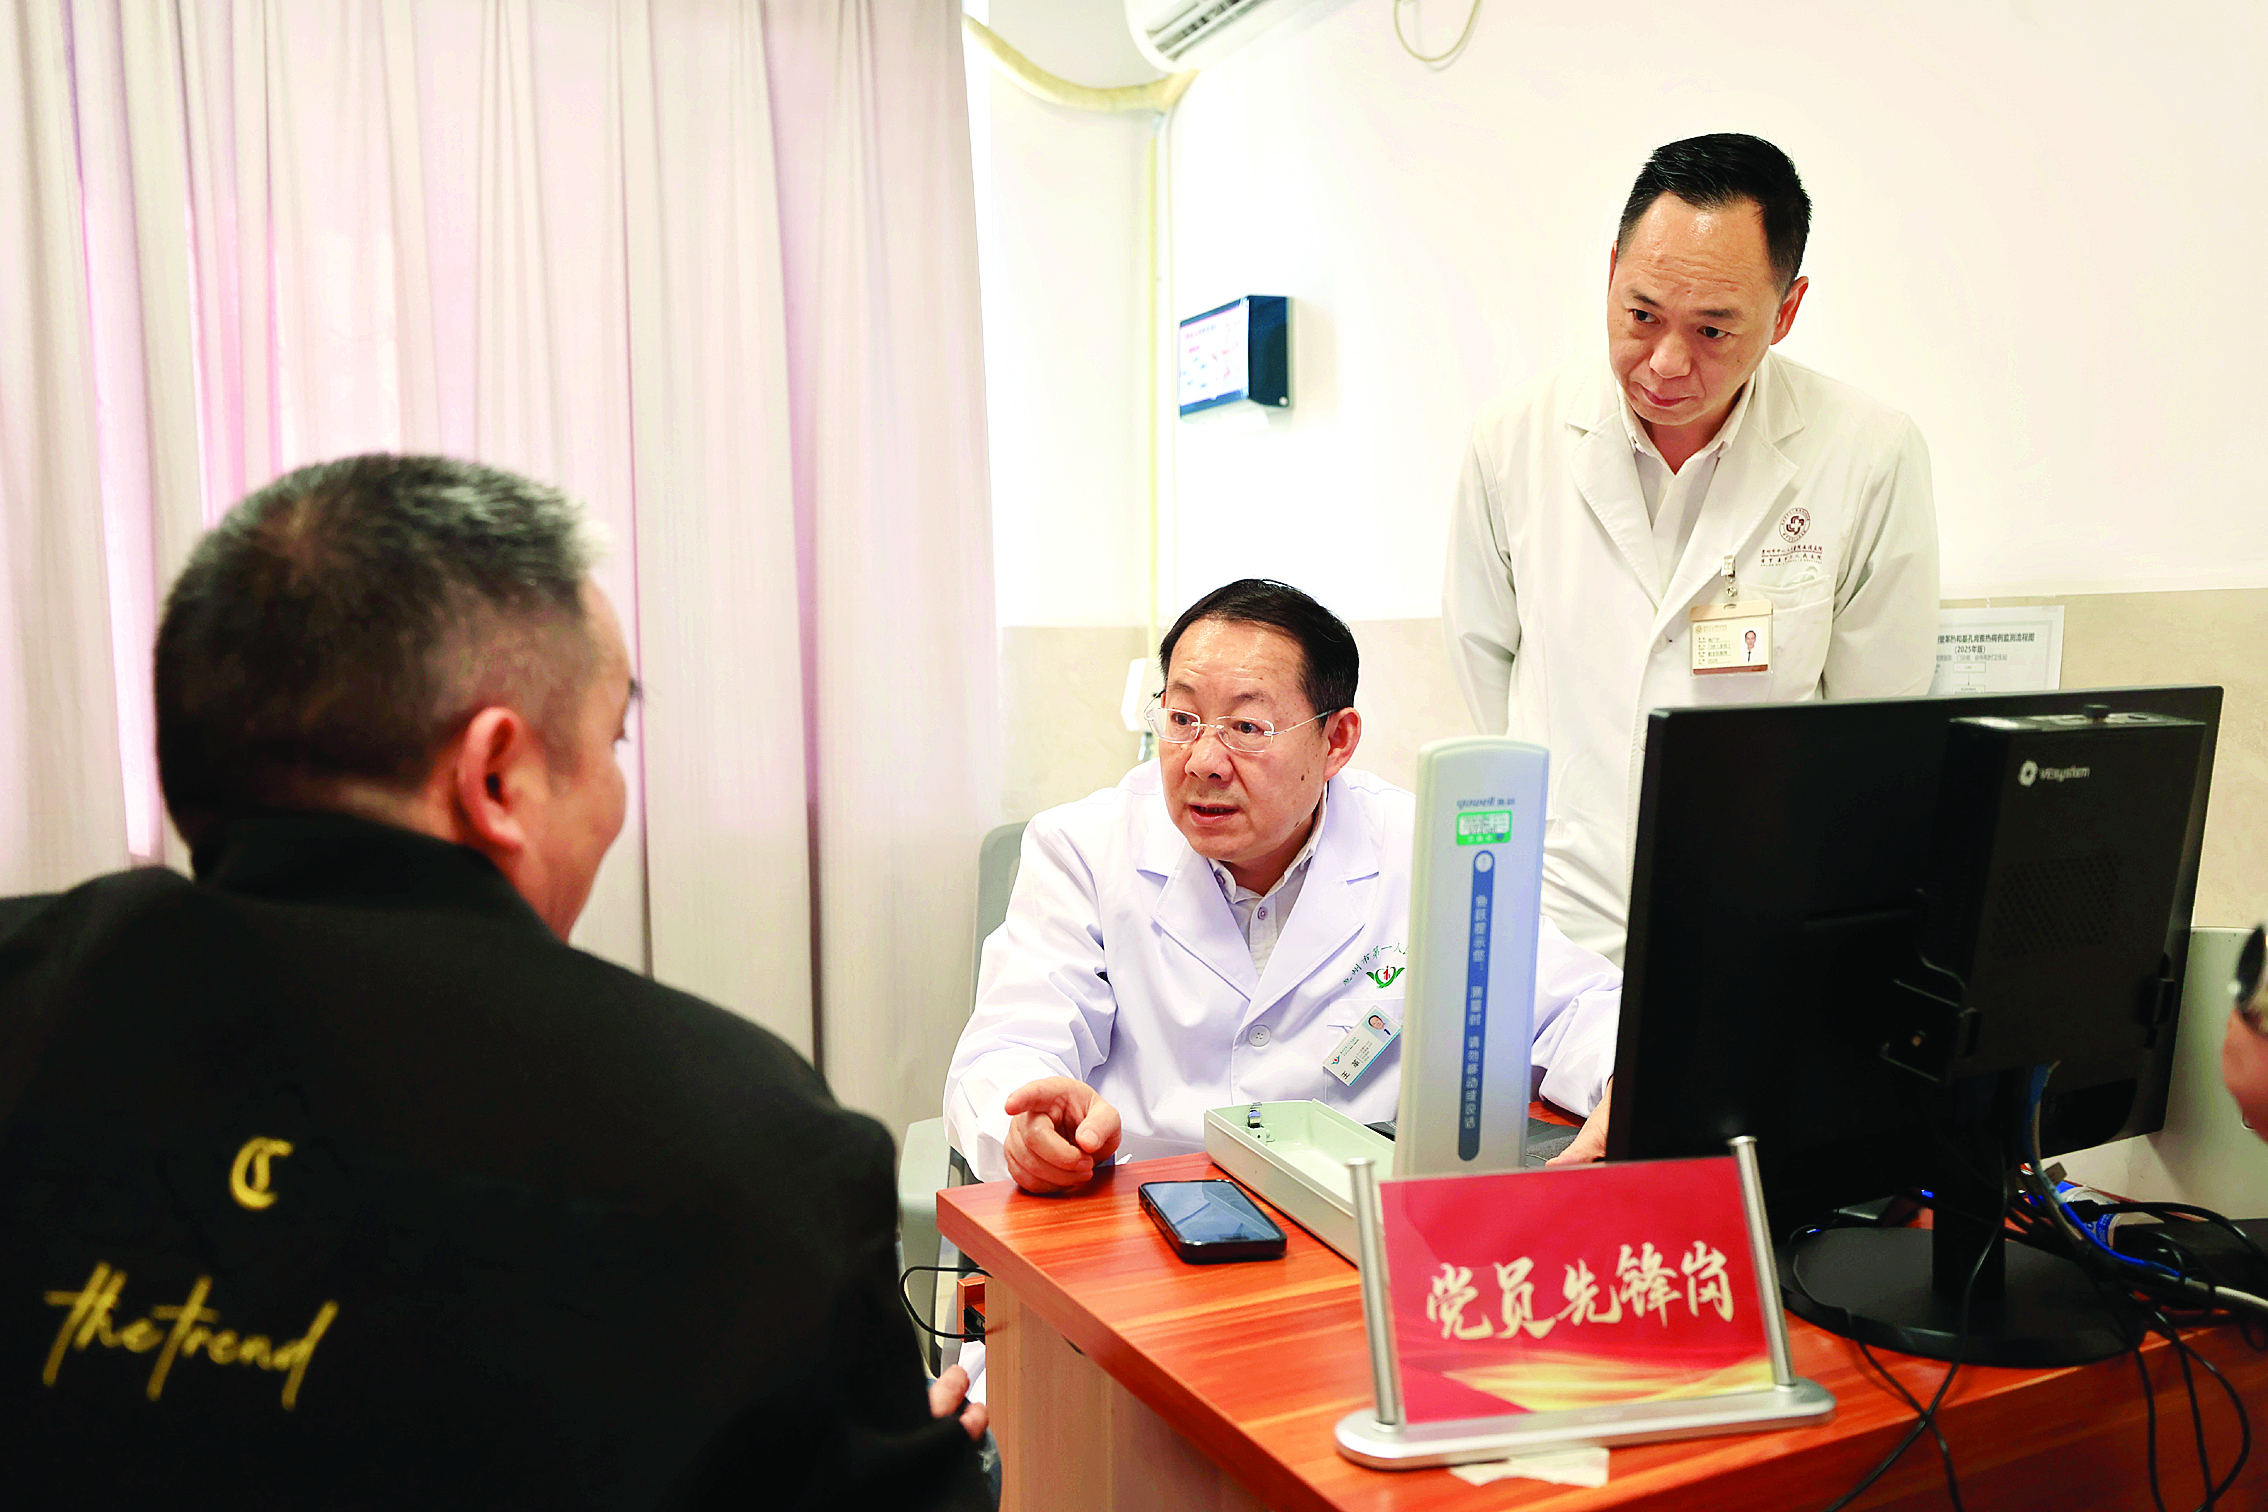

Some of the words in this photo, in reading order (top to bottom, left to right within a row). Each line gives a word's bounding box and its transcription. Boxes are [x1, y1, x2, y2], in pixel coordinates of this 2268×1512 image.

[1937, 633, 2035, 644] 登革热和基孔肯雅热病例监测流程图
[1426, 1240, 1734, 1340] 党员先锋岗
